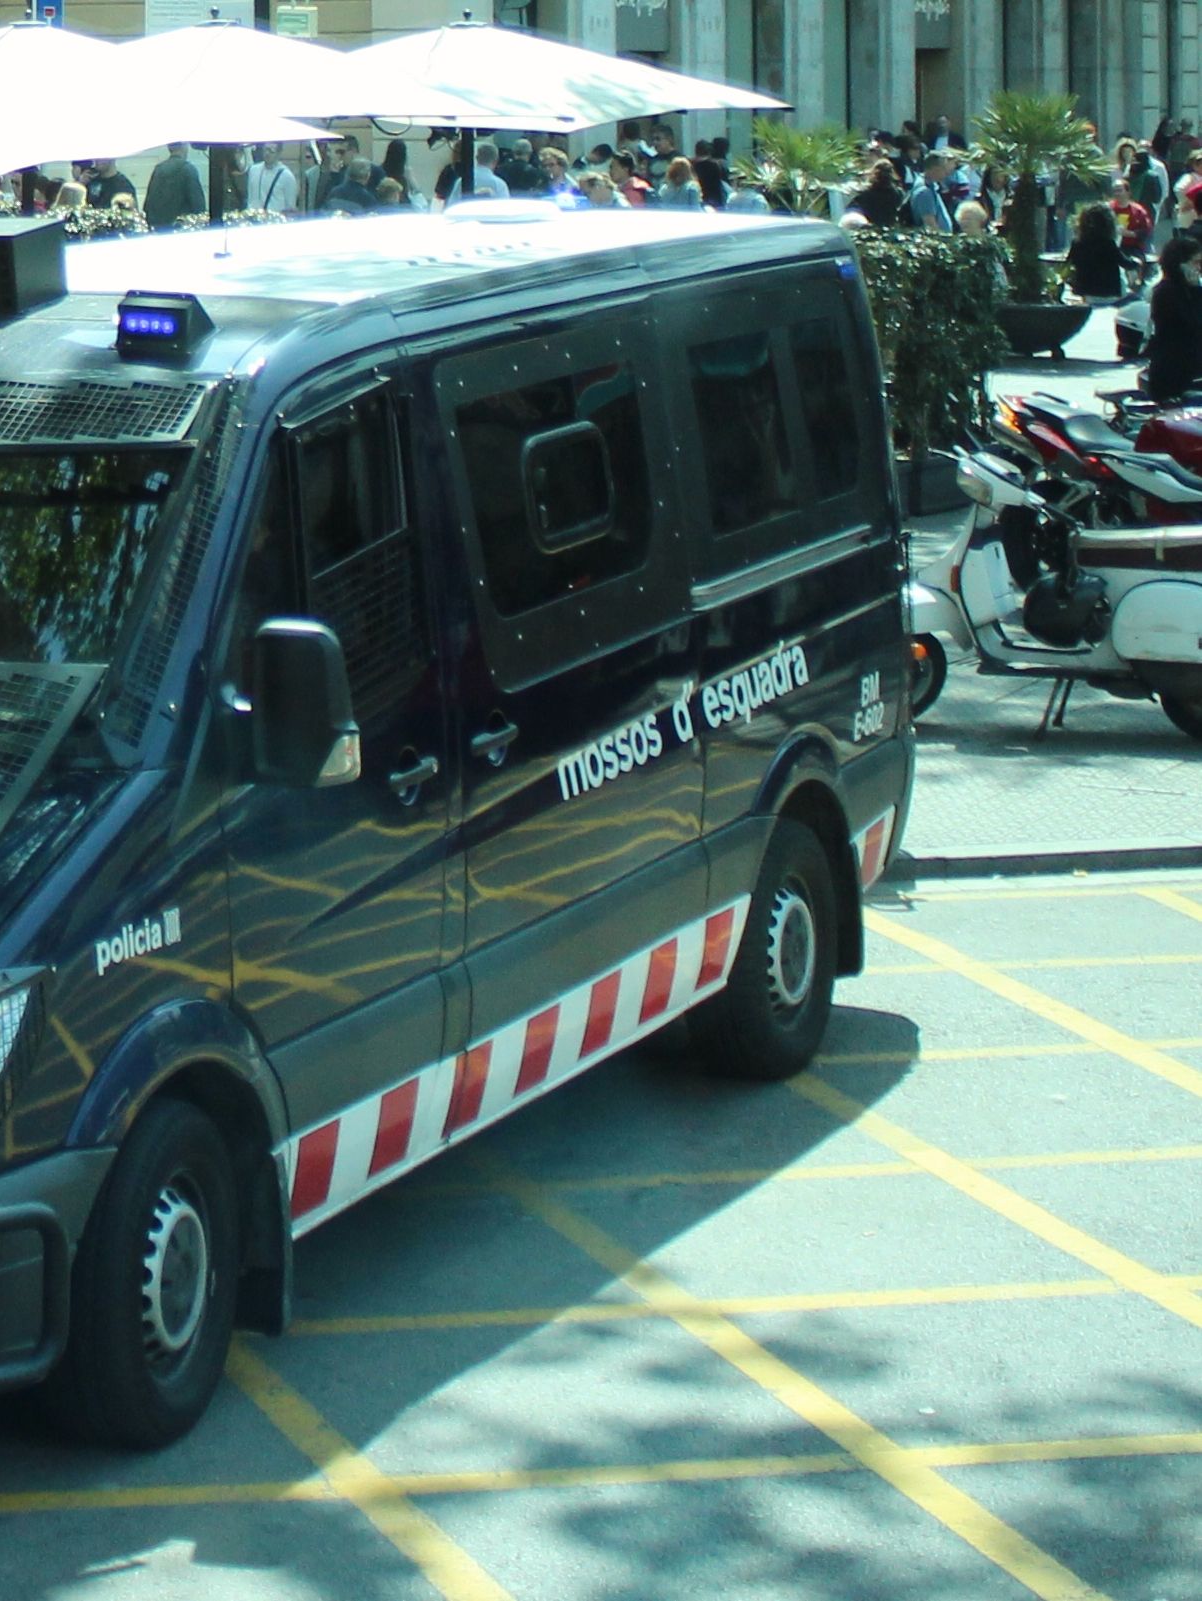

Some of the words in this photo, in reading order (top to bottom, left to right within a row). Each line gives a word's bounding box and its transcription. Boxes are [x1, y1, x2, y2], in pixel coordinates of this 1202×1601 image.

[557, 713, 663, 800] mossos
[702, 640, 809, 723] esquadra
[96, 917, 163, 976] policia
